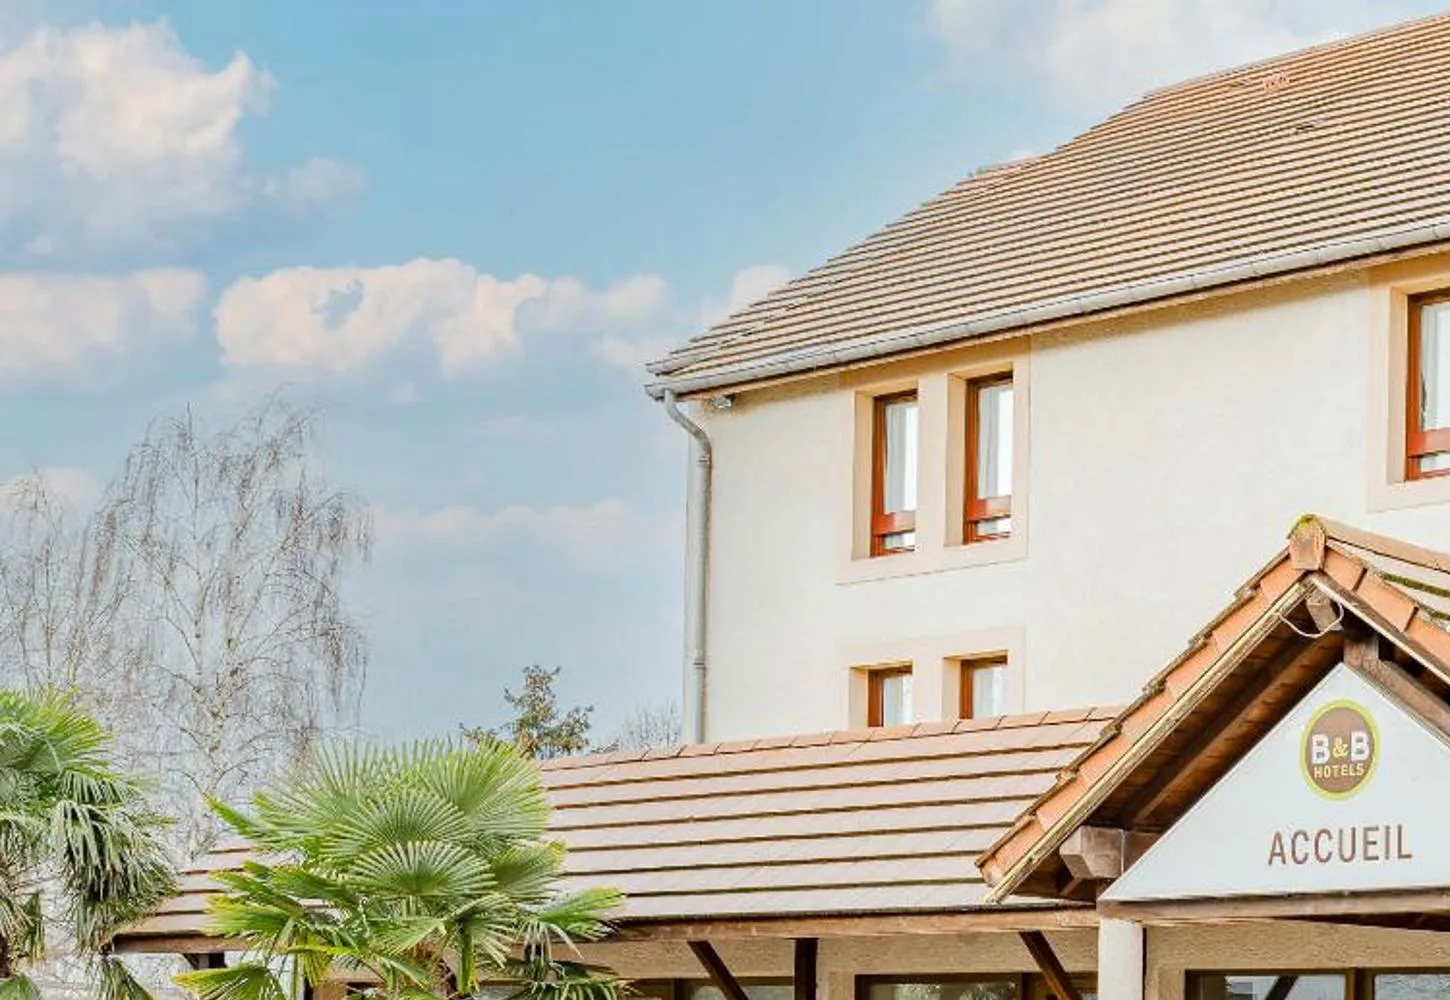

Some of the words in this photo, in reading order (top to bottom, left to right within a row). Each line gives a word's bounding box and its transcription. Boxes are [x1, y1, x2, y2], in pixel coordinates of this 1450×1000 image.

[1312, 732, 1370, 764] B&B
[1314, 763, 1364, 779] HOTELS
[1268, 824, 1413, 866] ACCUEIL
